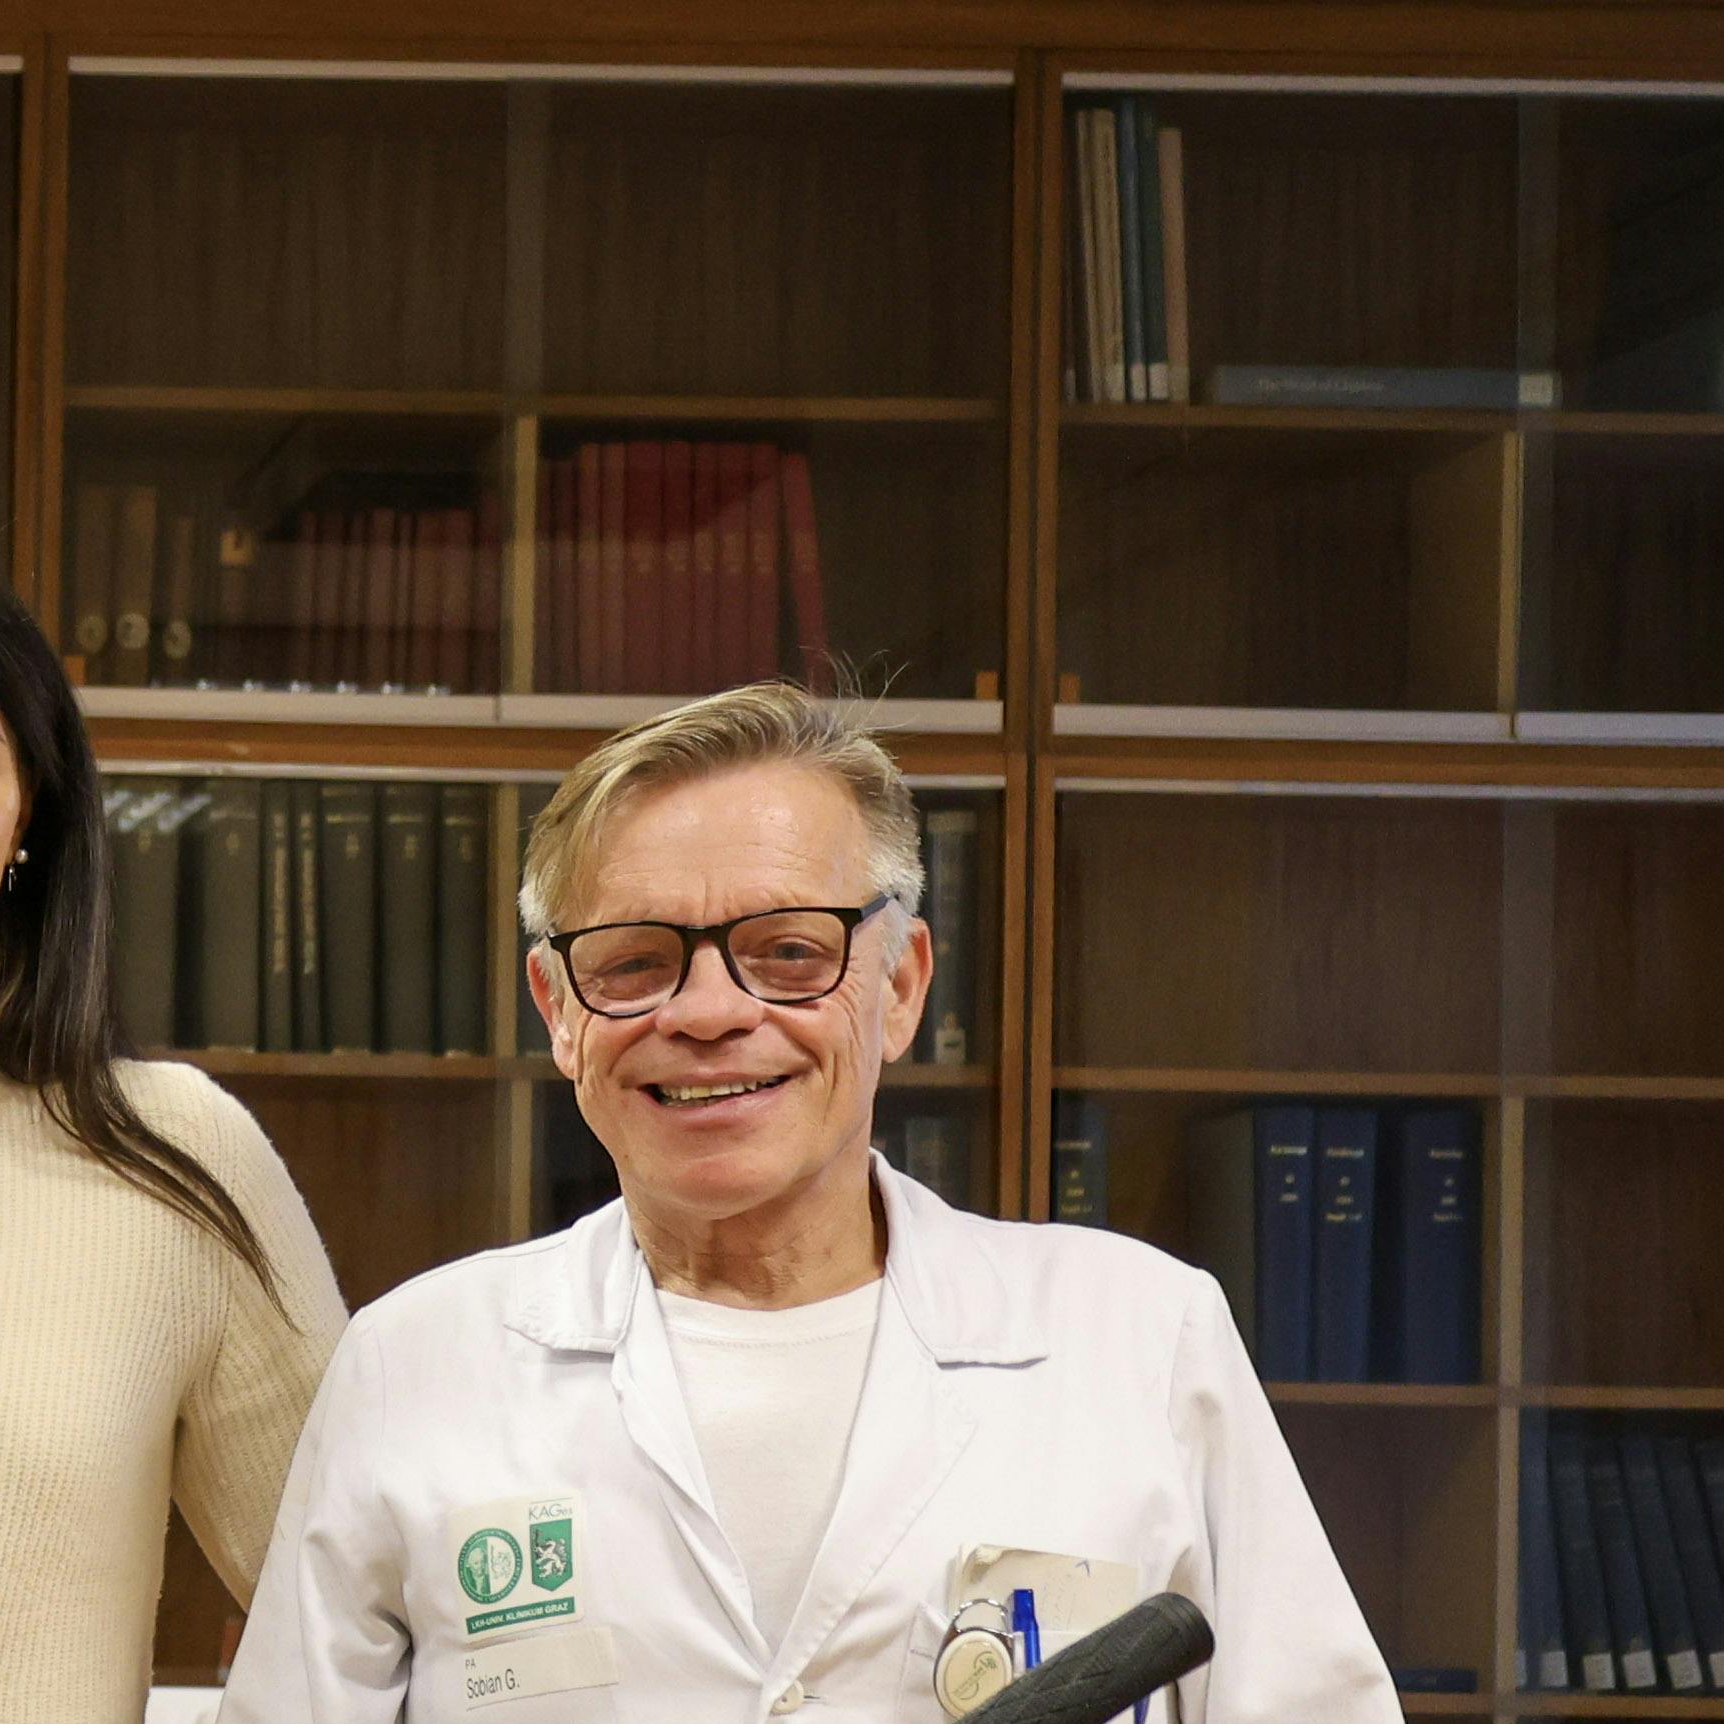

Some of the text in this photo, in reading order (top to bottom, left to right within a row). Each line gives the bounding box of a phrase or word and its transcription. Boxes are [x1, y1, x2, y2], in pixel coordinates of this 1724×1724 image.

[505, 1606, 544, 1622] KLINIKUM
[544, 1601, 569, 1614] GRAZ
[466, 1668, 520, 1700] Sobian G.
